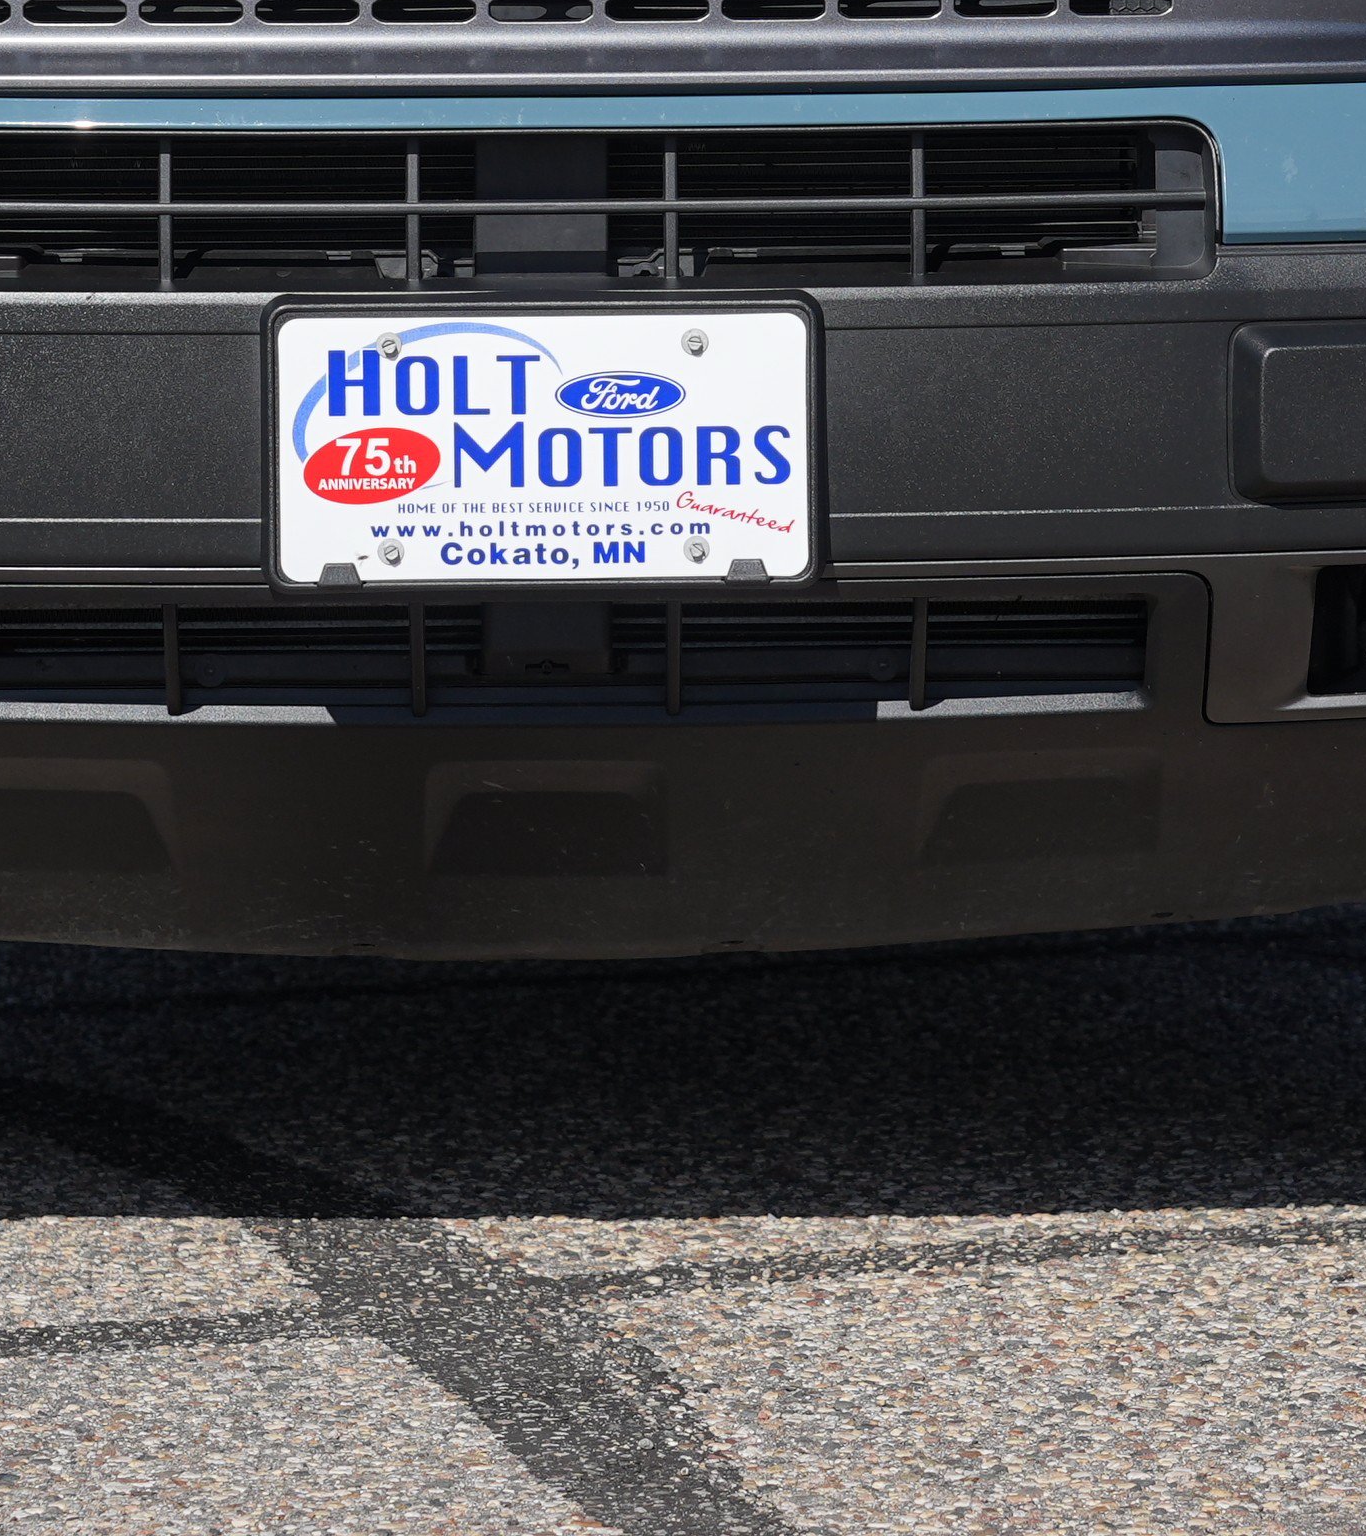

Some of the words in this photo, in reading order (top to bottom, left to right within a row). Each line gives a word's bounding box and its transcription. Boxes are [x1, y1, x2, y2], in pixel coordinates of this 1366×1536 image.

[327, 349, 541, 417] HOLT
[580, 376, 661, 411] Ford
[335, 437, 417, 477] 75th
[453, 421, 792, 489] MOTORS
[317, 476, 417, 492] ANNIVERSARY
[397, 502, 437, 514] HOME
[442, 502, 458, 514] OF
[462, 502, 487, 514] THE
[491, 502, 524, 514] BEST
[528, 501, 585, 514] SERVICE
[589, 501, 630, 513] SINCE
[636, 500, 671, 512] 1950
[675, 490, 796, 534] Guaranteed
[370, 520, 712, 538] www.holtmotors.com
[440, 541, 580, 570] Cokato,
[592, 540, 646, 564] MN
